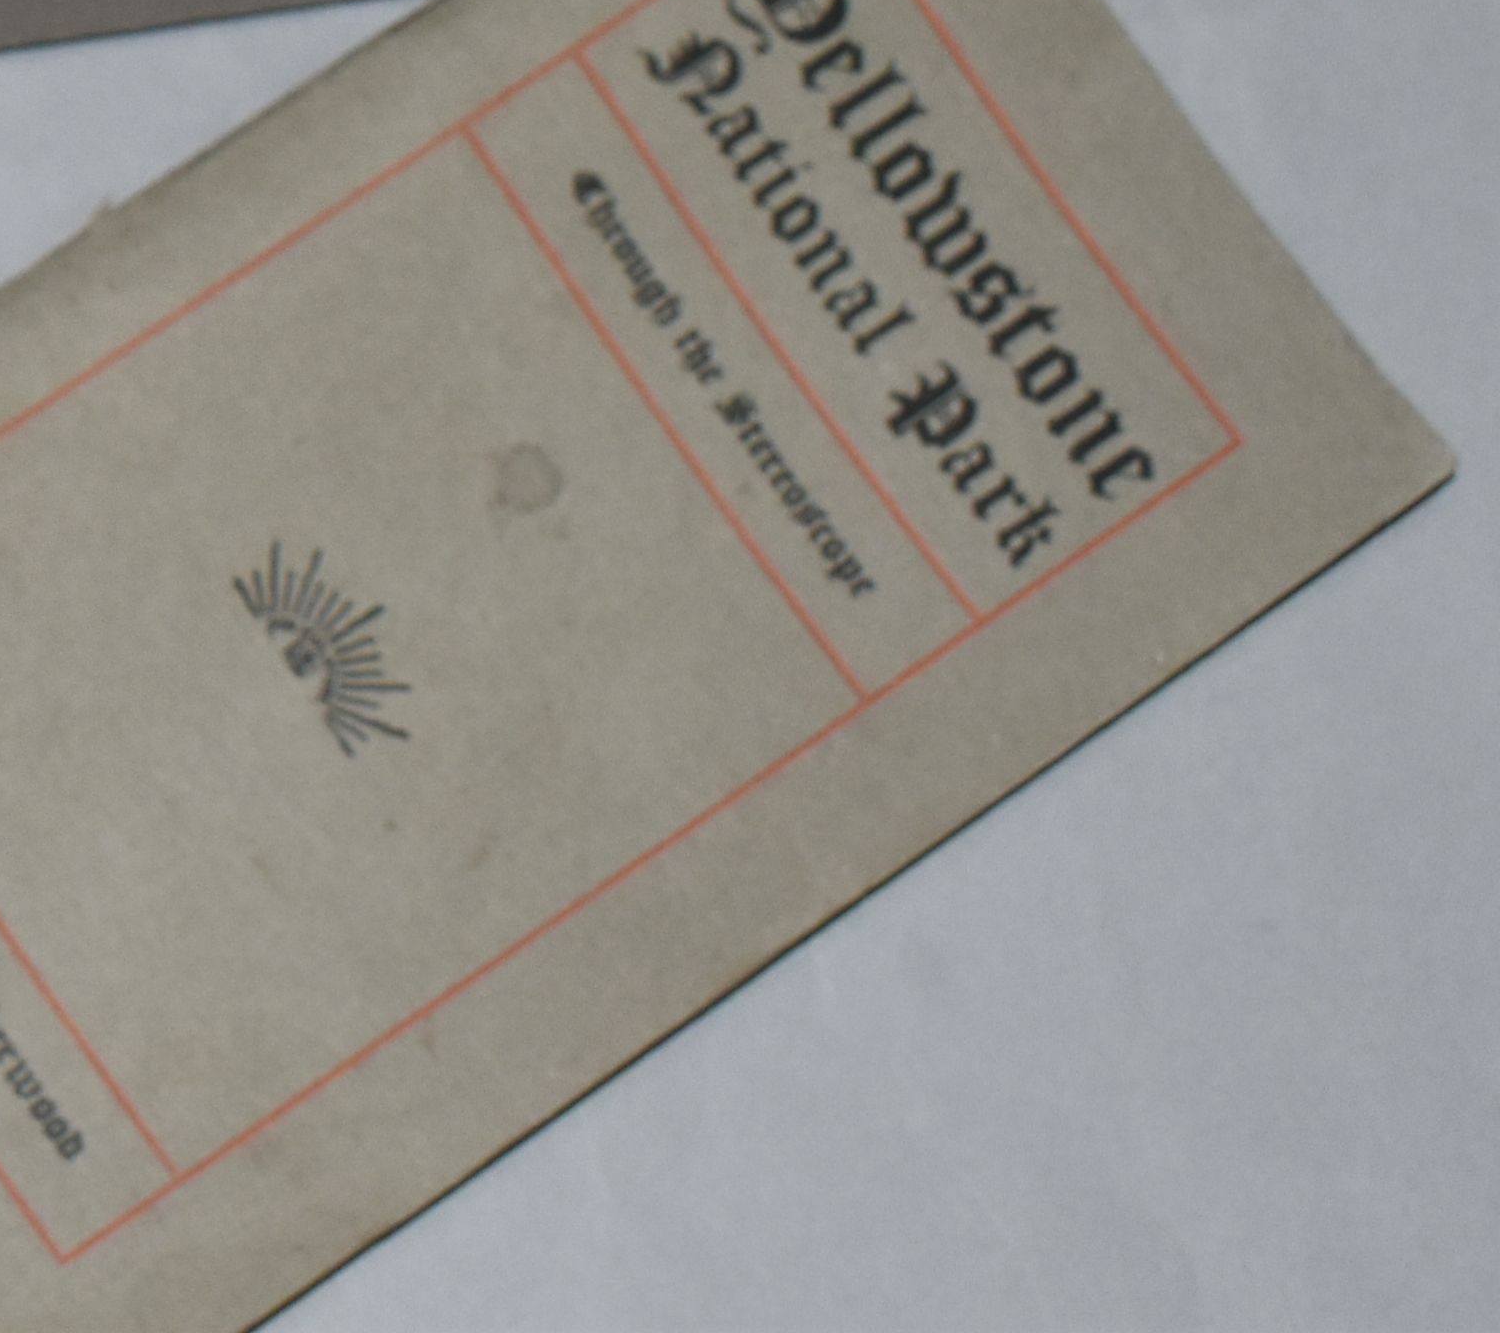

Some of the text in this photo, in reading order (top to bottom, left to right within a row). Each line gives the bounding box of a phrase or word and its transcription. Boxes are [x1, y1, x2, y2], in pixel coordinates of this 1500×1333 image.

[573, 169, 876, 598] Through the Stereoscope
[637, 31, 1061, 569] National Park
